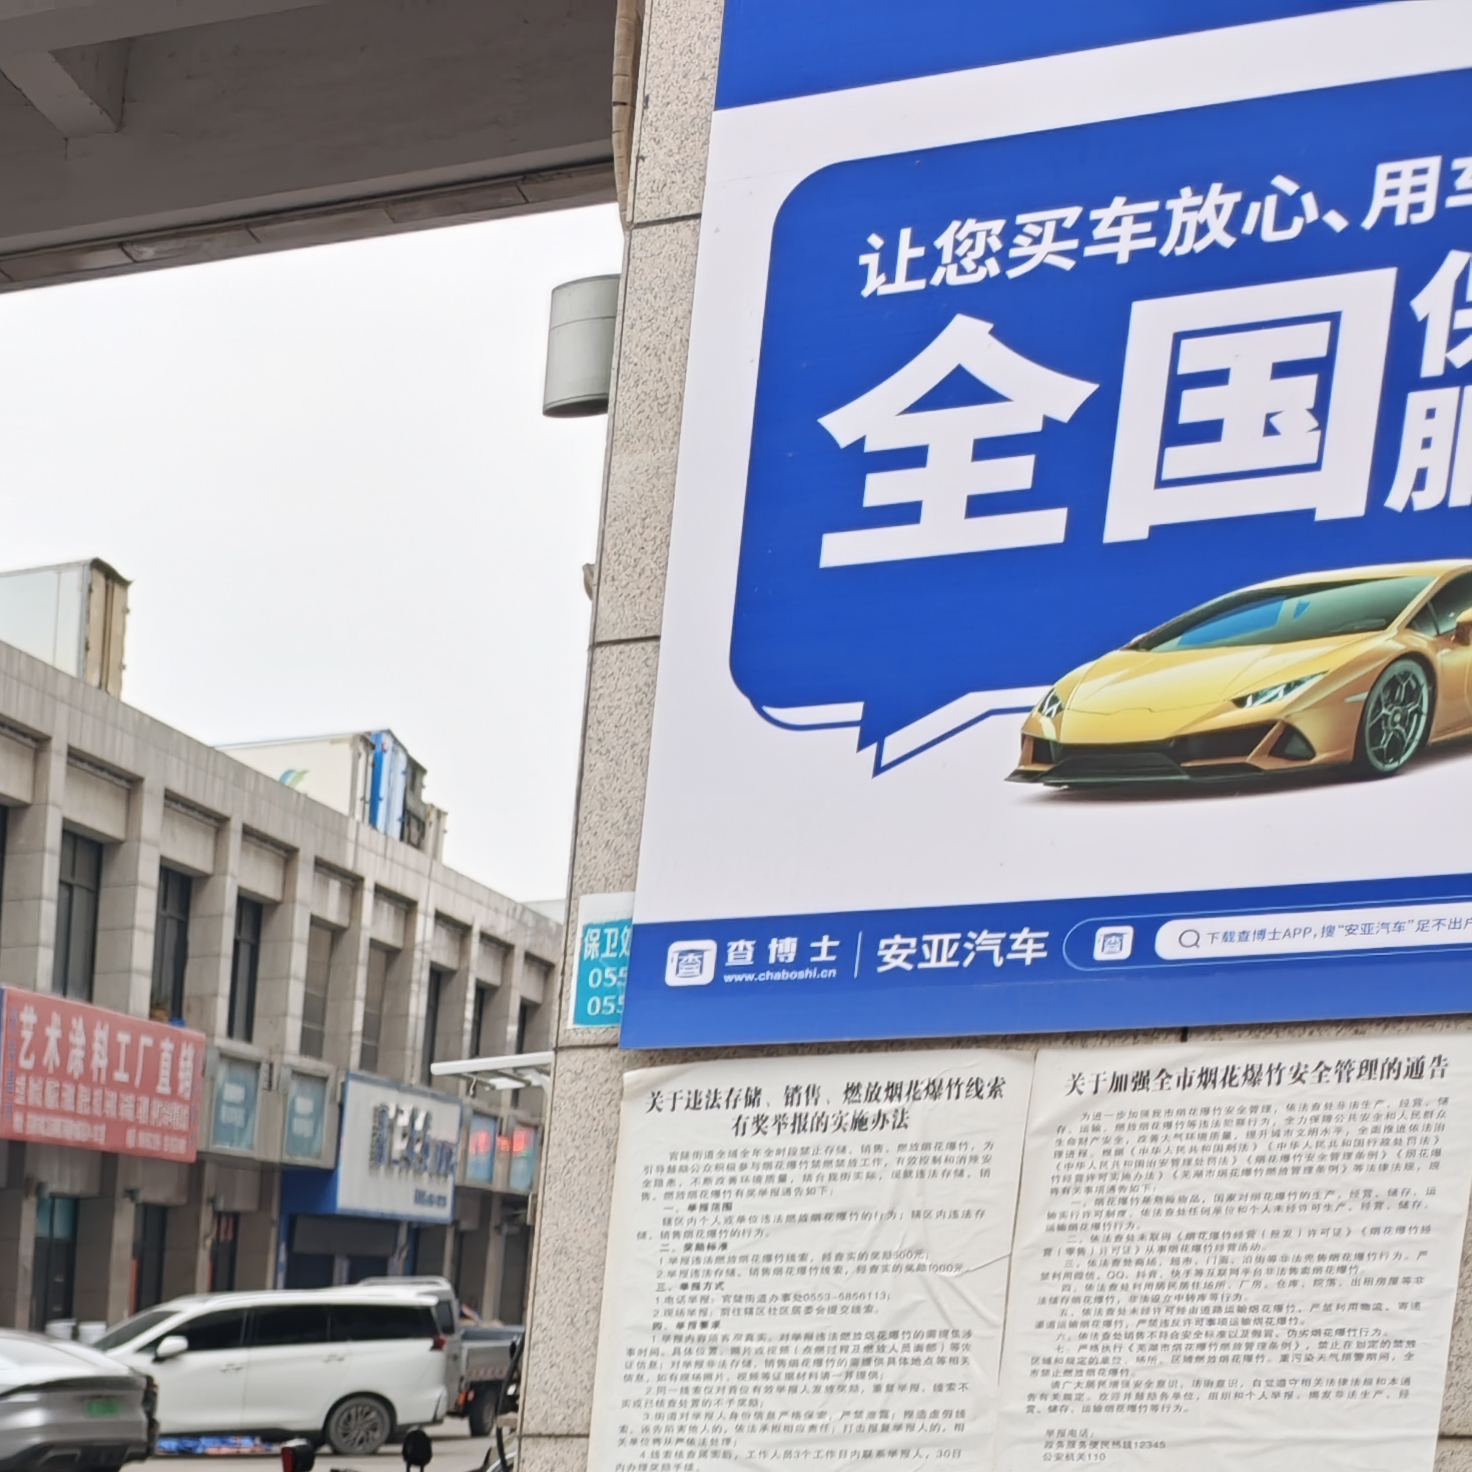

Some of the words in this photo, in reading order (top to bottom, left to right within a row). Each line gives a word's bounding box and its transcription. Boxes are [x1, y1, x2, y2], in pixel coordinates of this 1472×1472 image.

[725, 935, 840, 966] 查博士
[877, 926, 1050, 973] 安亚汽车
[723, 967, 837, 983] www.chaboshi.cn
[1064, 1054, 1450, 1097] 关于加强全市烟花爆竹安全管理的通告
